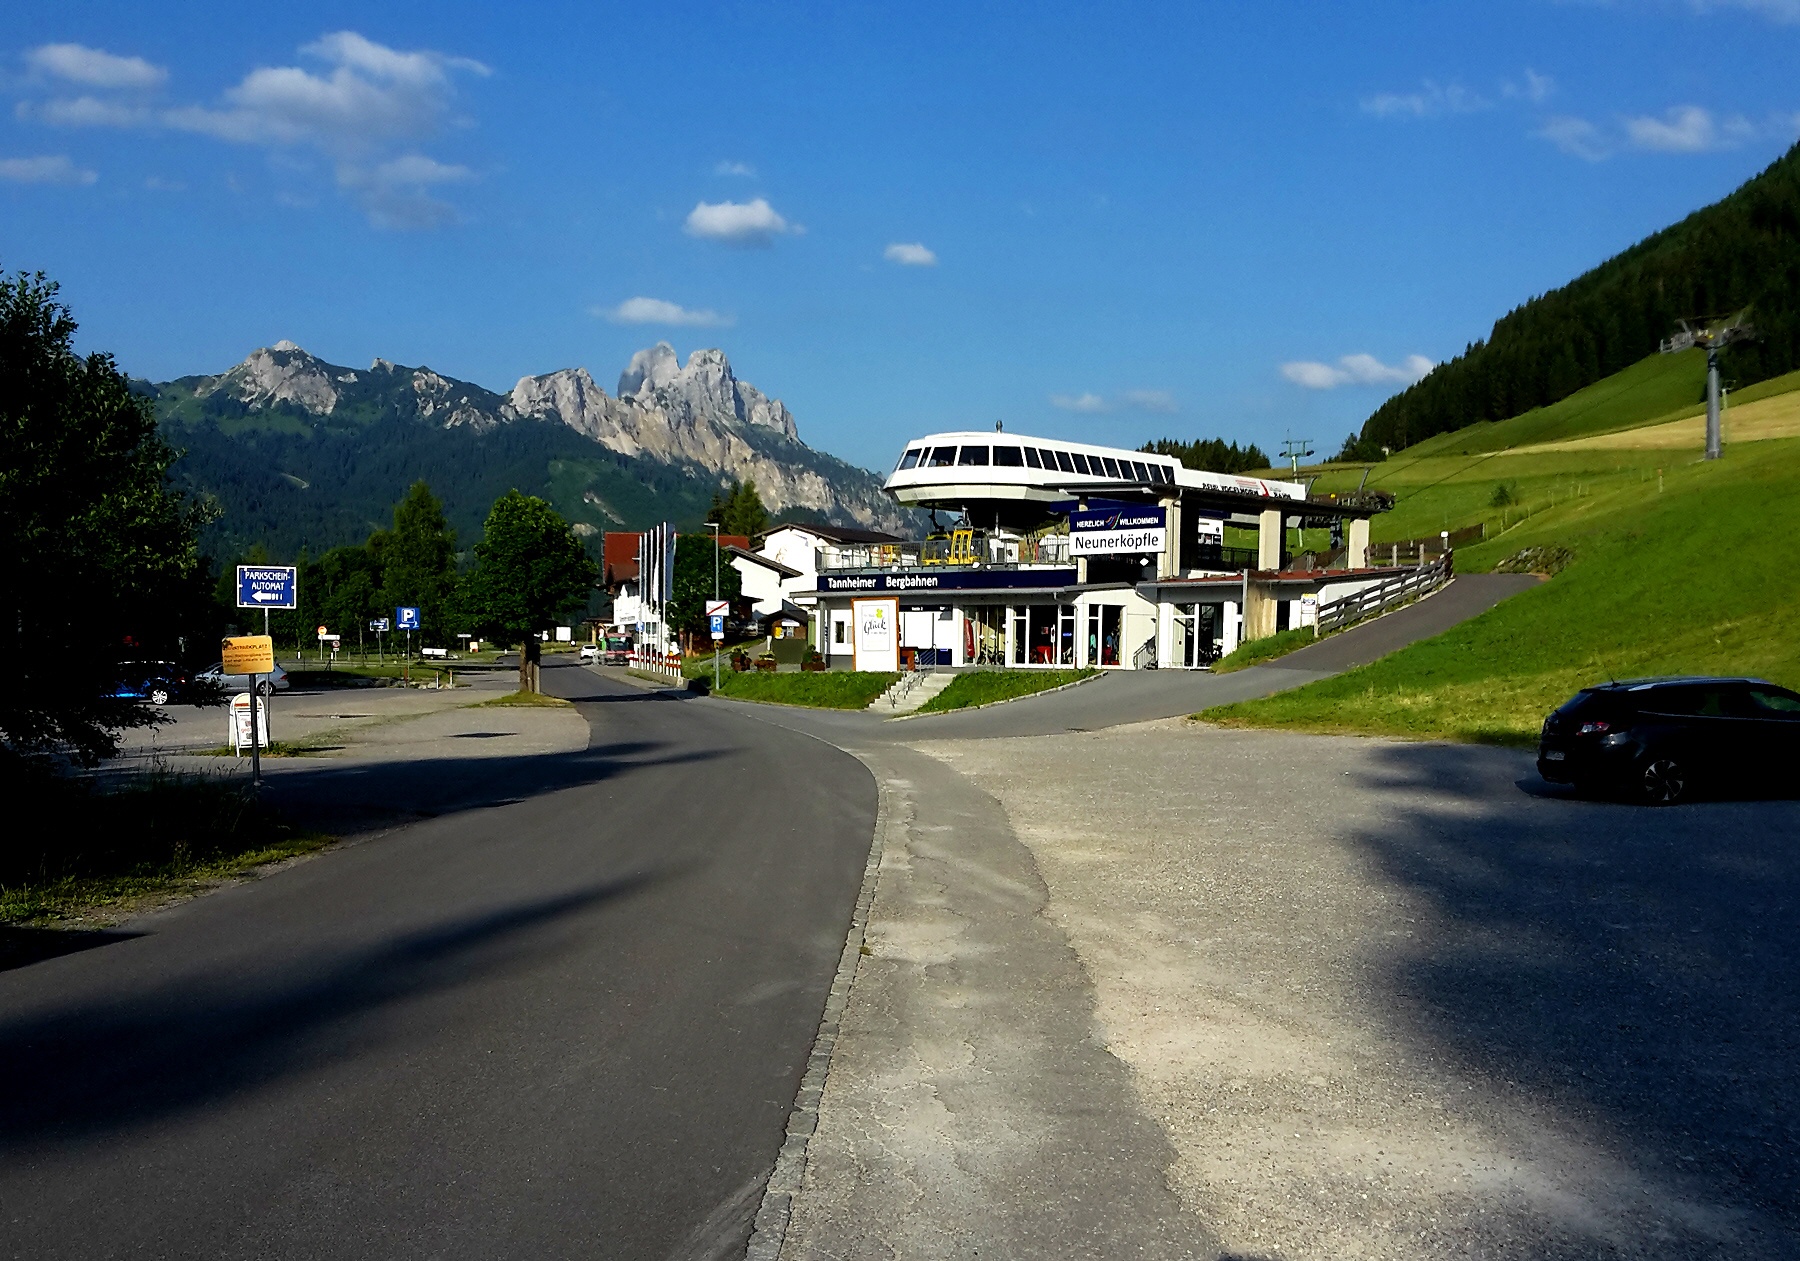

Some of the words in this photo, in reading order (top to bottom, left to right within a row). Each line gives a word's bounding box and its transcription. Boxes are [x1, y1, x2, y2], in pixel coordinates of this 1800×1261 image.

[1076, 519, 1105, 529] HERZLICH
[1119, 516, 1159, 526] WILLKOMMEN
[1075, 532, 1159, 550] Neunerköpfle
[245, 571, 291, 581] PARKSCHEIN-
[827, 577, 877, 589] Tannheimer
[886, 575, 938, 589] Bergbahnen
[252, 582, 285, 591] AUTOMAT
[404, 610, 413, 622] P
